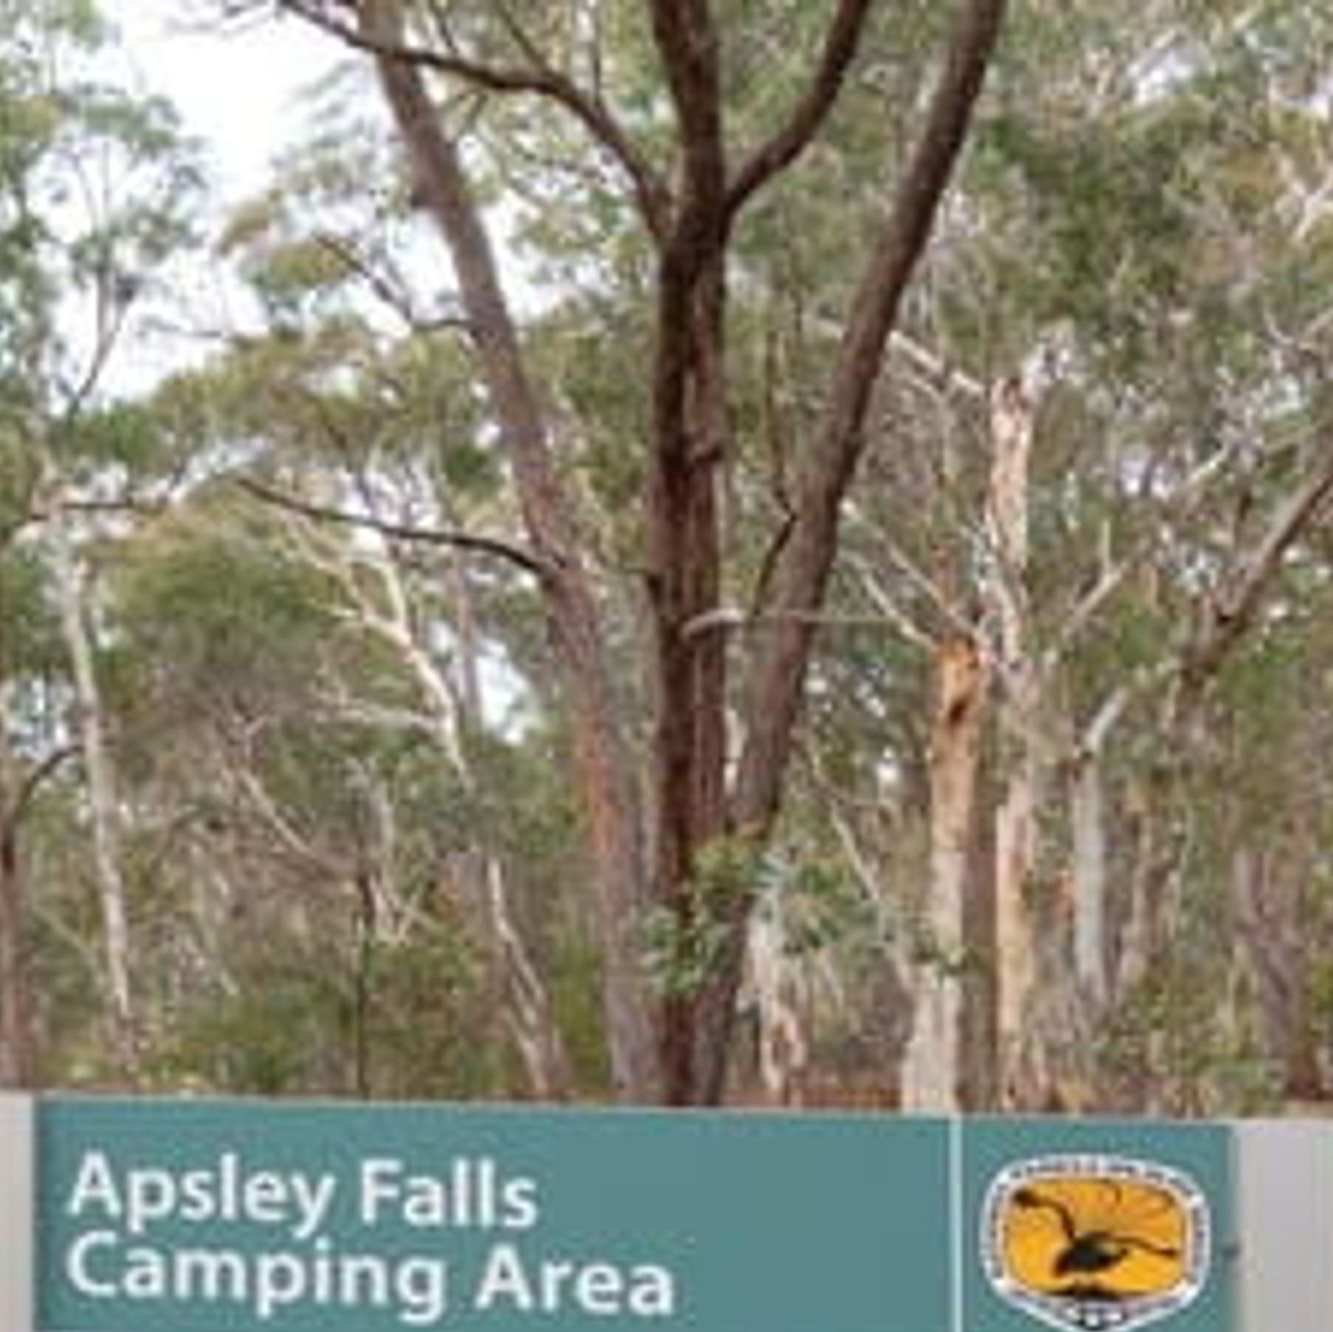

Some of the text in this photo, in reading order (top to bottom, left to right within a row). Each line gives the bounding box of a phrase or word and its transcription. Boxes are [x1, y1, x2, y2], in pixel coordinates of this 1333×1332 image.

[67, 1151, 538, 1240] Apsley Falls
[66, 1230, 675, 1326] Camping Area
